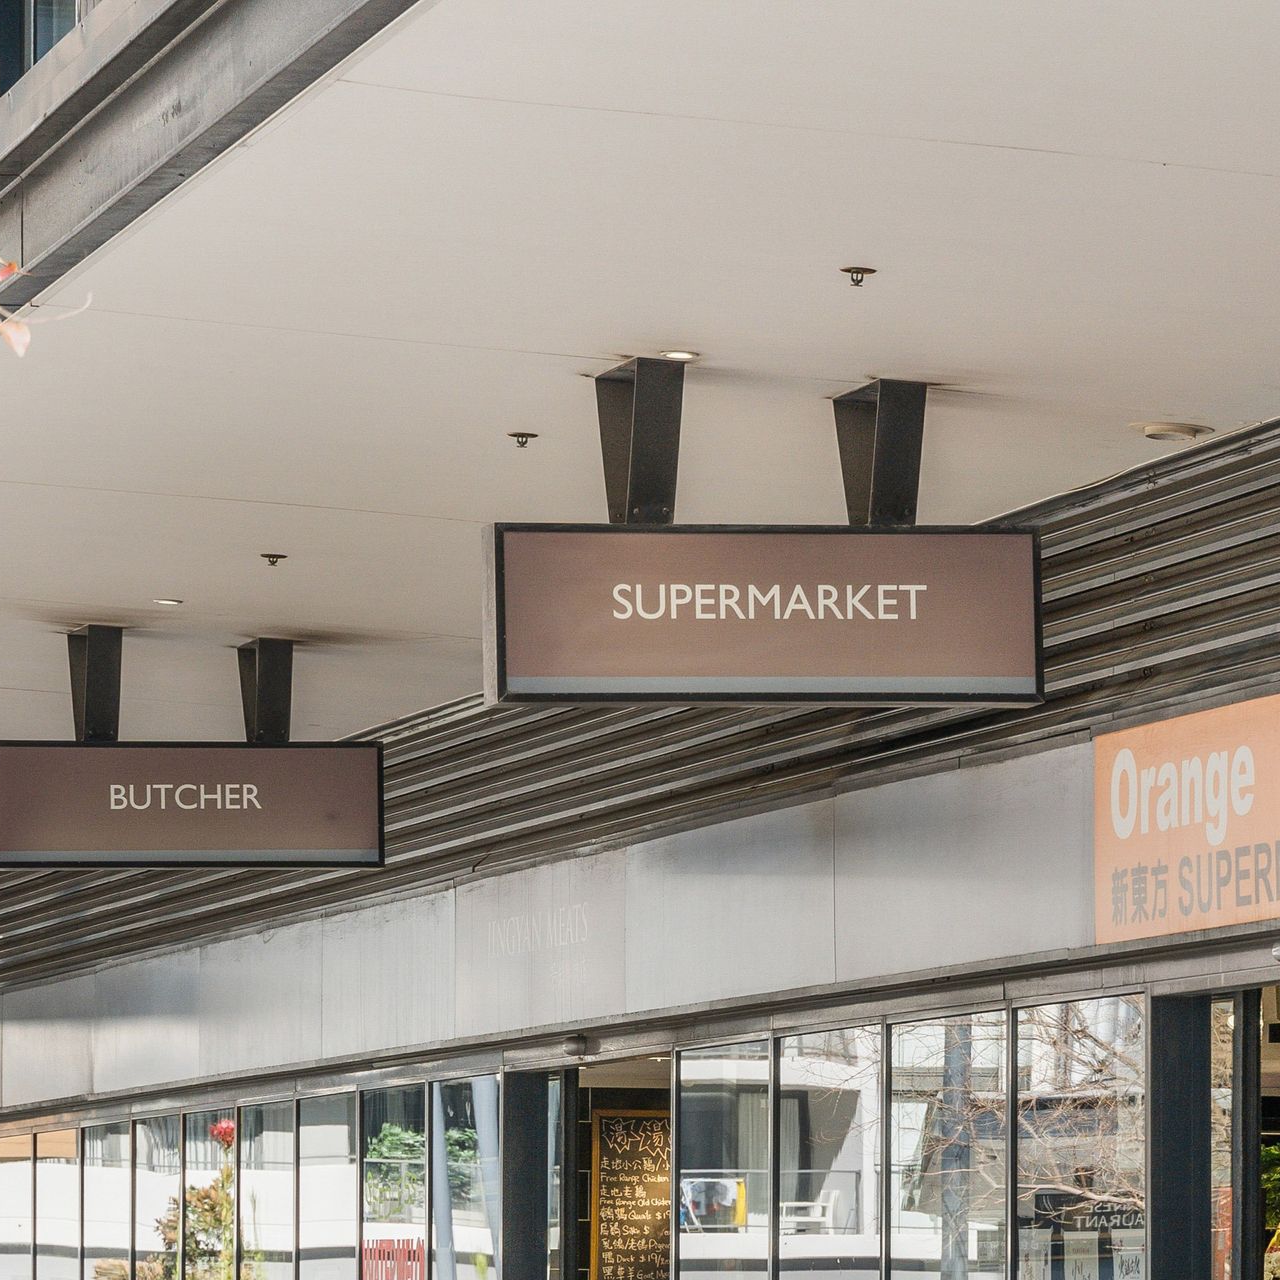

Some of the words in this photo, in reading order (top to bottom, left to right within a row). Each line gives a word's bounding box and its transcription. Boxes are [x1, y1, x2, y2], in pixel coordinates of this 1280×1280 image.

[612, 583, 927, 620] SUPERMARKET
[109, 784, 262, 810] BUTCHER
[1111, 745, 1255, 846] Orange
[1111, 858, 1168, 927] 新東方
[546, 902, 588, 949] MEATS
[600, 1174, 618, 1183] Free
[619, 1174, 640, 1186] Range
[642, 1174, 670, 1183] Chicken
[616, 1255, 636, 1264] Duck
